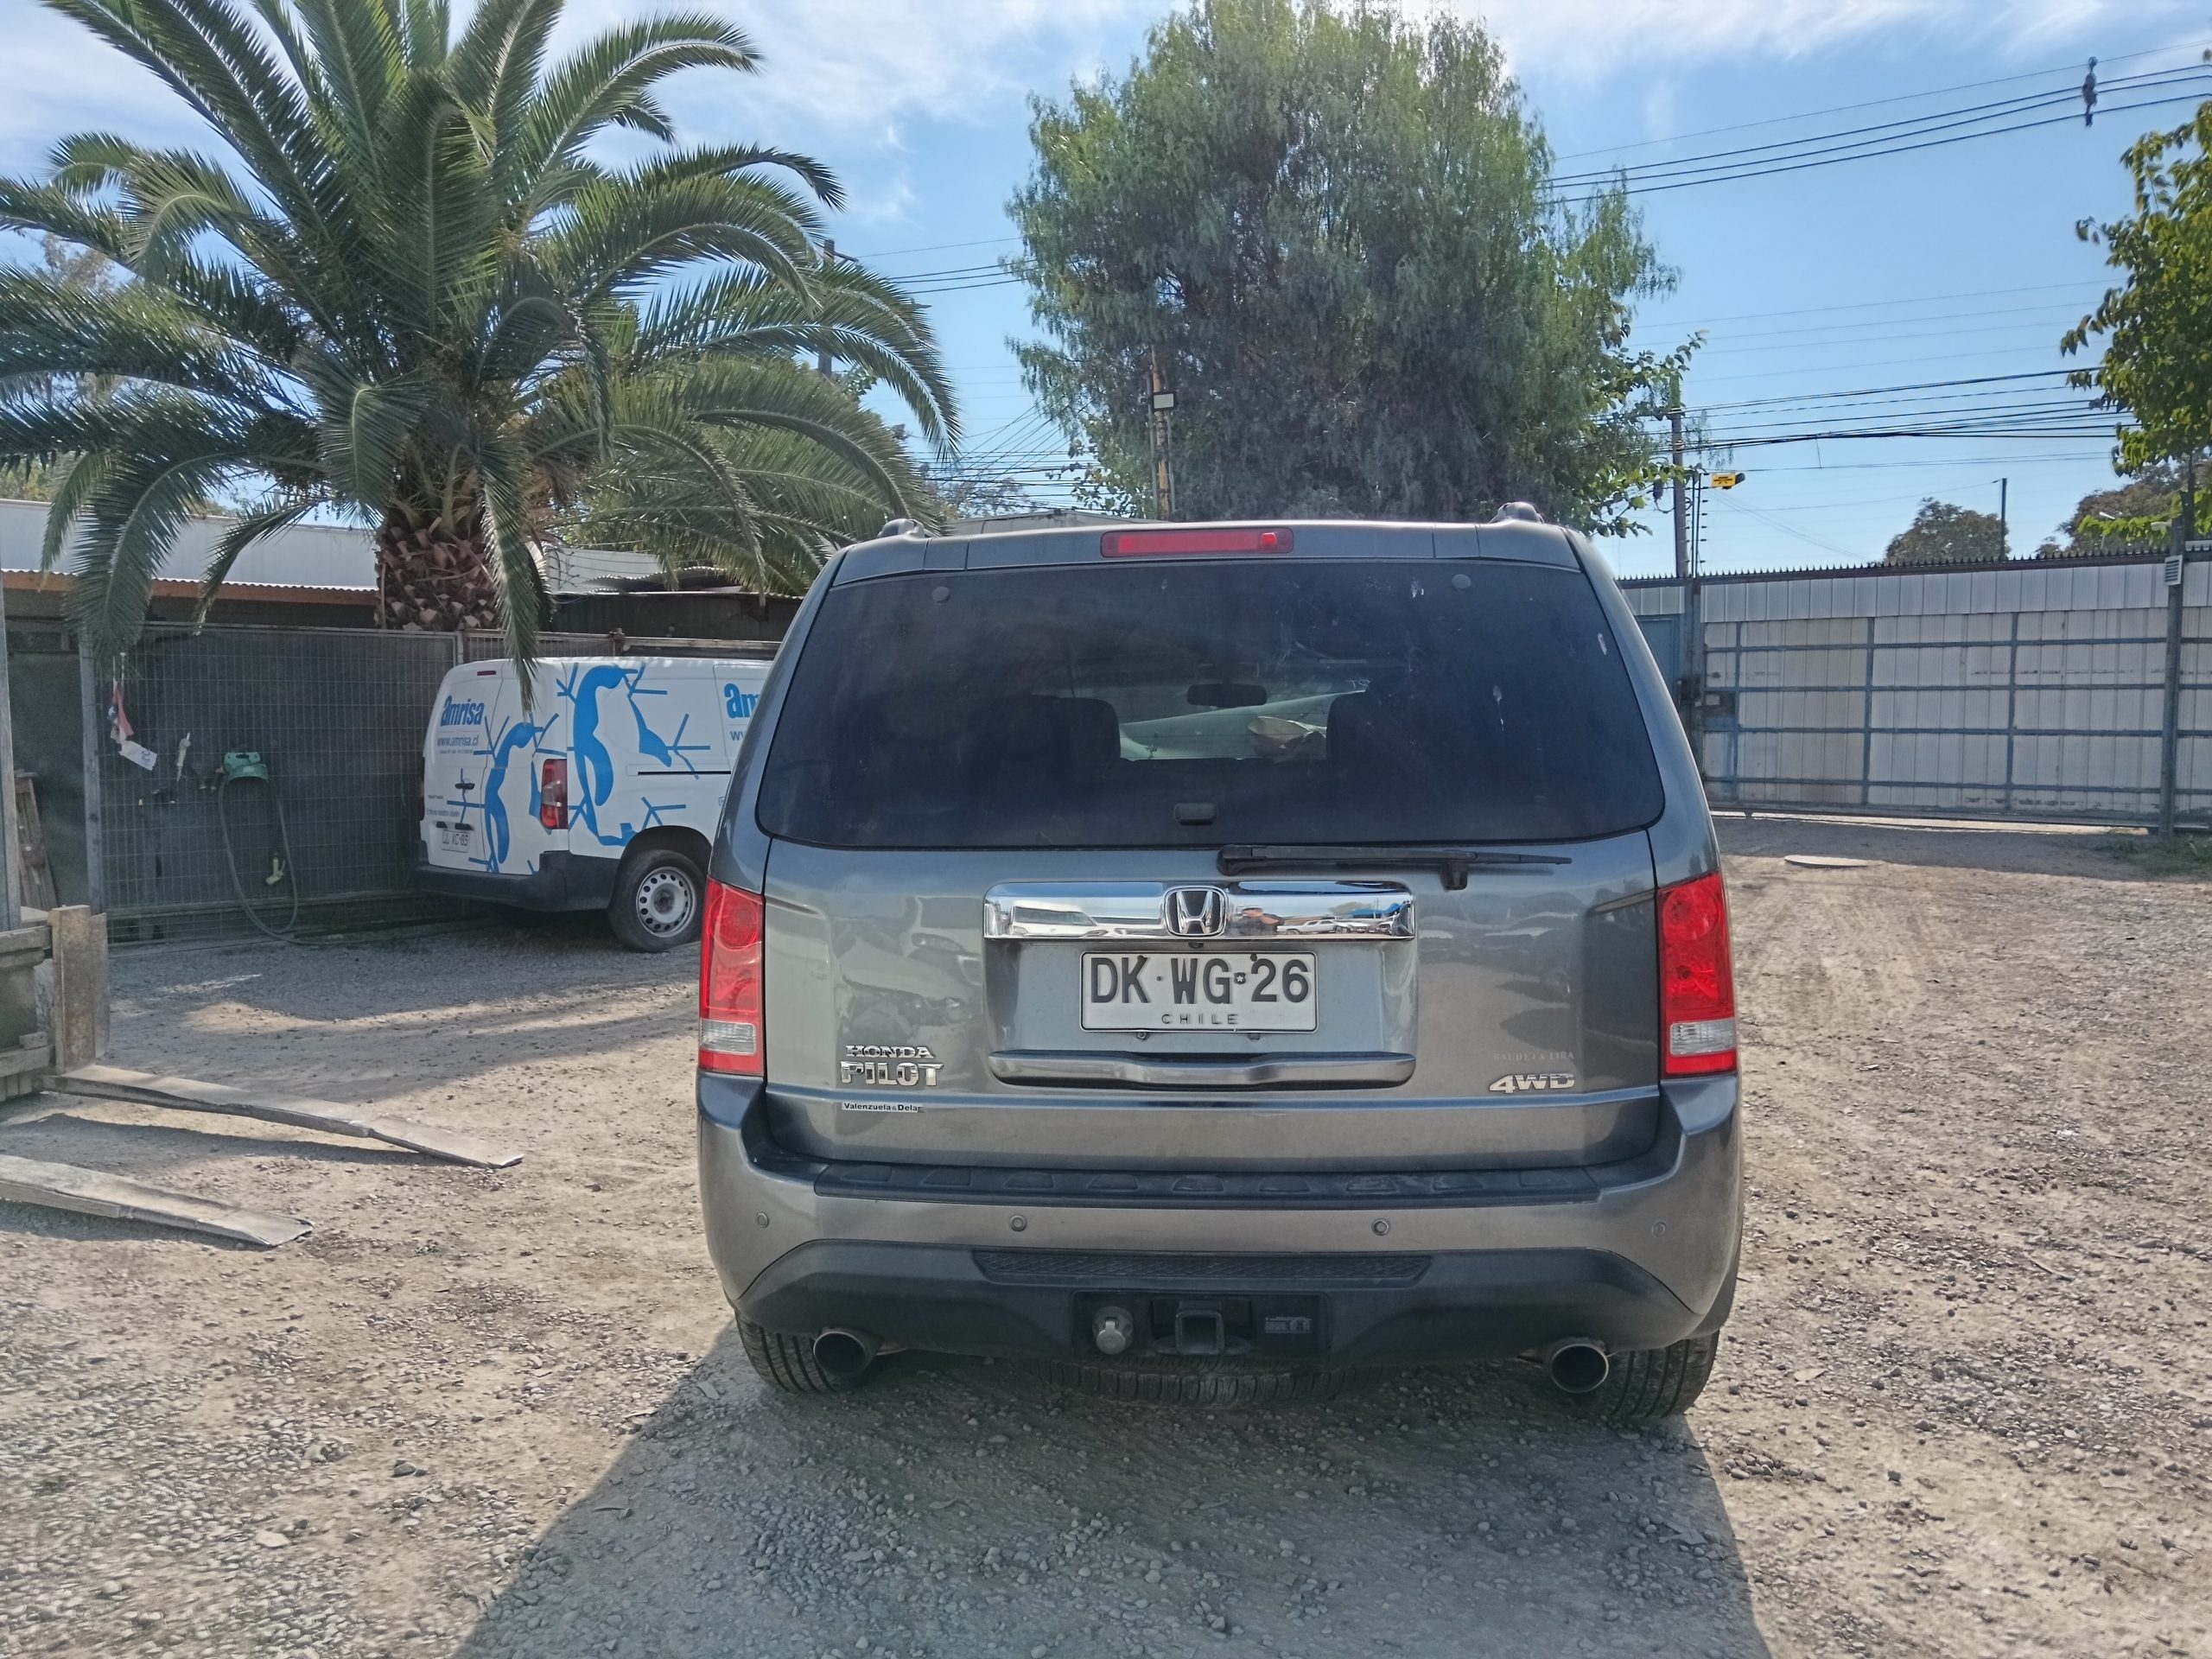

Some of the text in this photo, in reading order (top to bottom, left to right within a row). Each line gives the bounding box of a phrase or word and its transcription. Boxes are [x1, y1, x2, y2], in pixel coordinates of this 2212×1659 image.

[440, 695, 485, 727] amrisa
[1160, 1013, 1240, 1026] CHILE
[845, 1045, 936, 1059] HONDA
[840, 1060, 944, 1087] PILOT
[1489, 1072, 1575, 1094] 4WD
